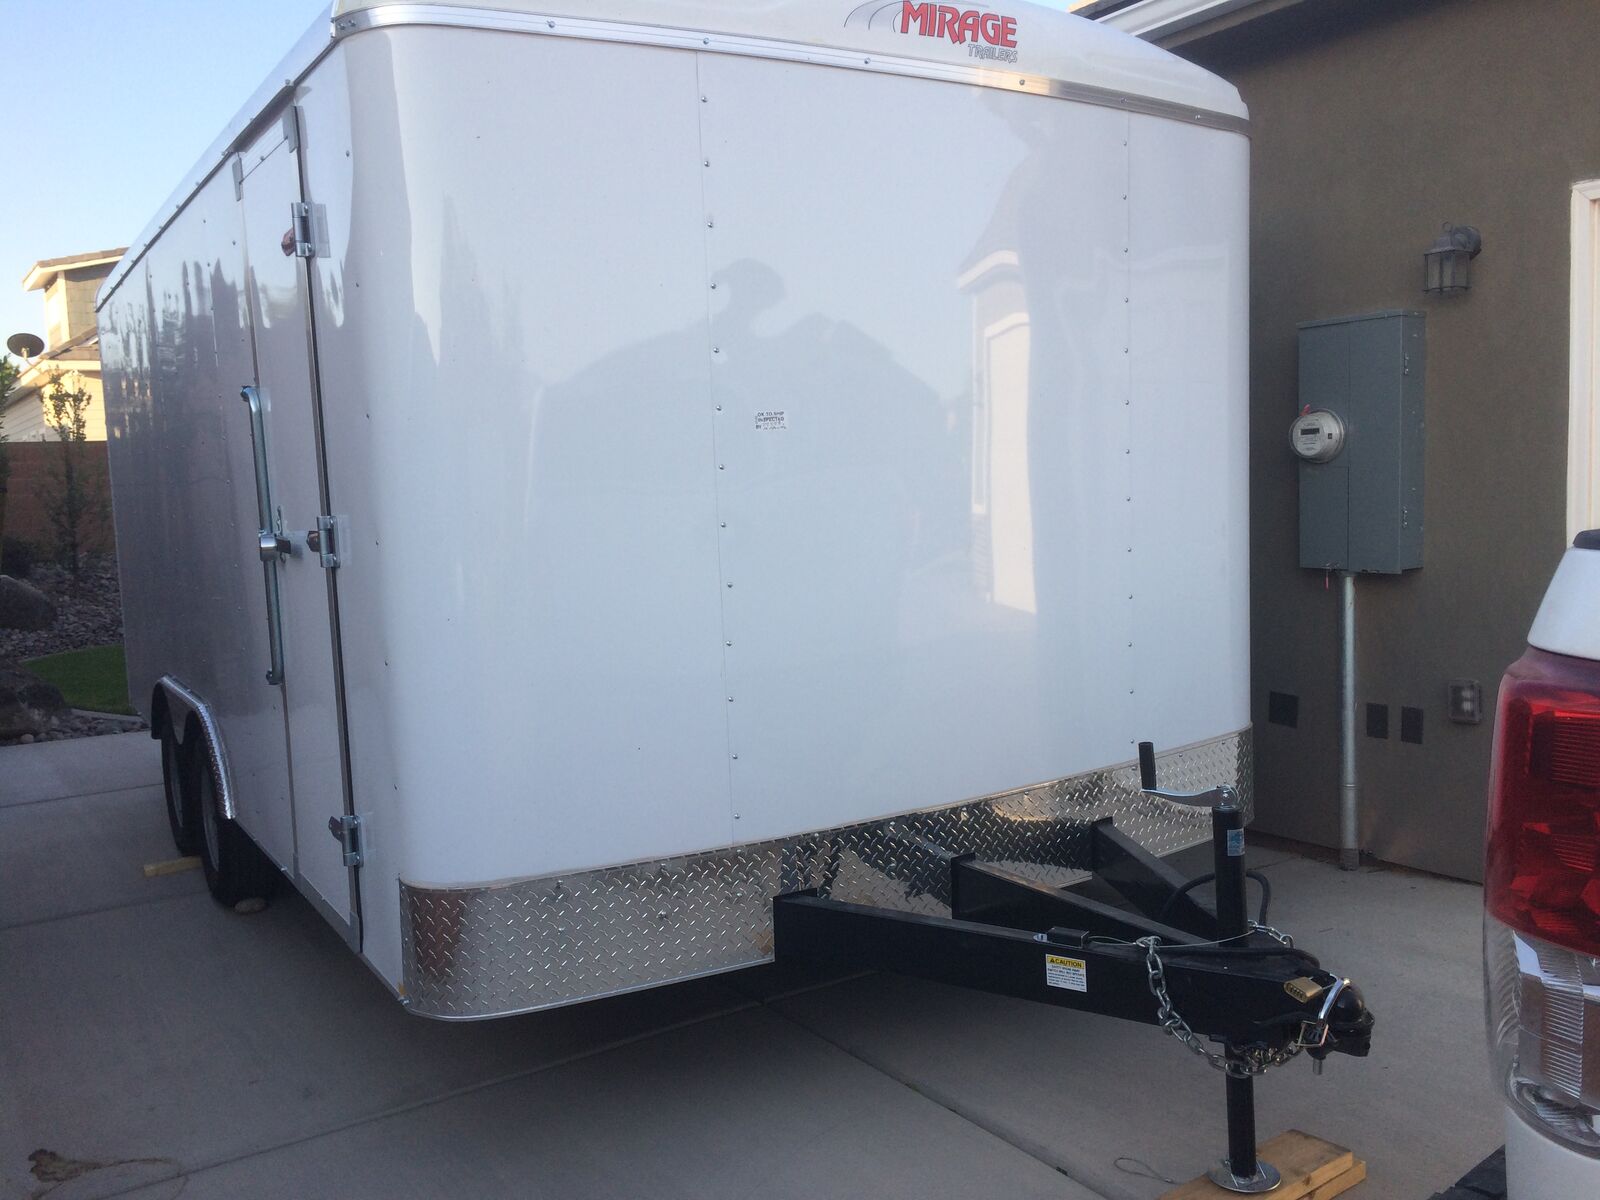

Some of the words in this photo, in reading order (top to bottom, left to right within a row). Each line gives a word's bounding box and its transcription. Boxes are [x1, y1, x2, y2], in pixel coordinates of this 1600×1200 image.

[900, 1, 1018, 48] MIRAGE
[968, 44, 1018, 63] TRAILERS
[1055, 959, 1082, 968] CAUTION
